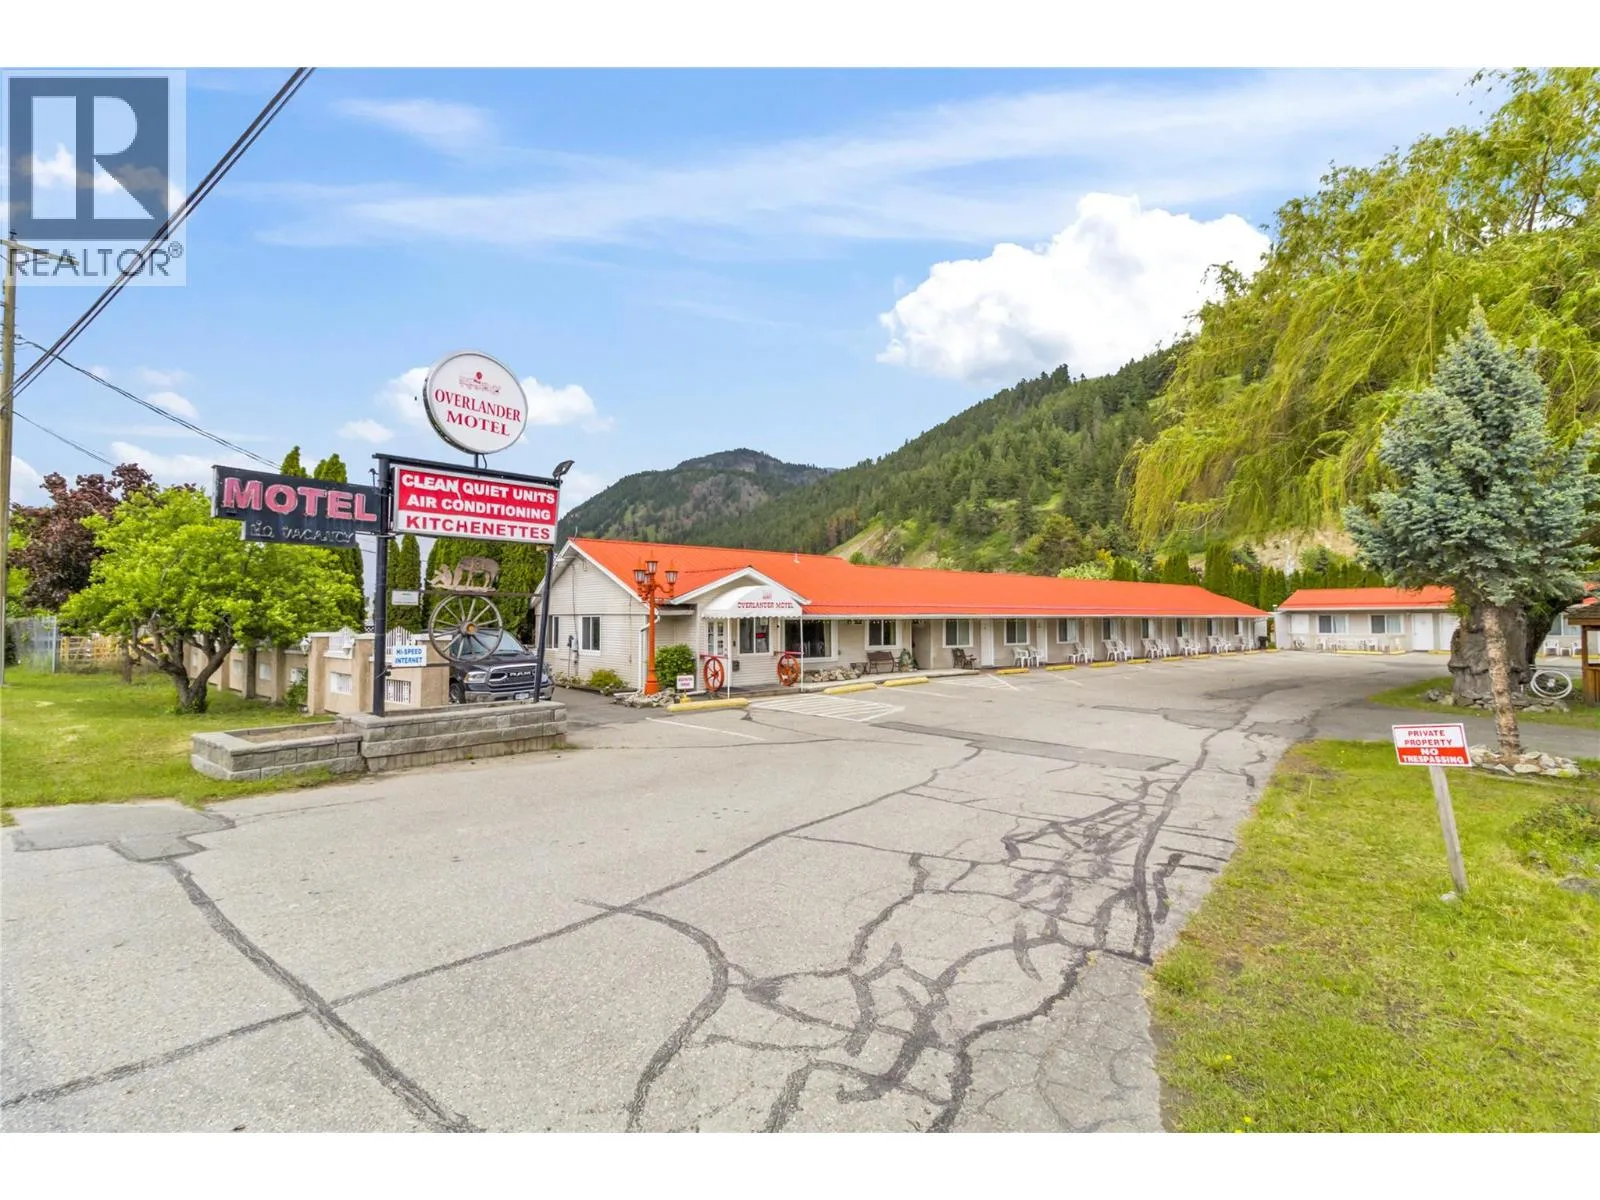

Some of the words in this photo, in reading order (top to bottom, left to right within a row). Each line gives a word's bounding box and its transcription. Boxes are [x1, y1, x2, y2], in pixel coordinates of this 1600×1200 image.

[435, 388, 521, 422] OVERLANDER
[446, 410, 511, 437] MOTEL
[222, 476, 378, 522] MOTEL
[401, 473, 459, 493] CLEAN
[462, 482, 509, 498] QUIET
[513, 488, 555, 504] UNITS
[406, 494, 437, 509] AIR
[441, 498, 550, 520] CONDITIONING
[406, 515, 550, 540] KITCHENETTES
[737, 601, 774, 609] OVERLANDER
[775, 601, 794, 609] MOTEL
[395, 656, 423, 664] INTERNET
[1402, 755, 1464, 764] TRESPASSING
[1420, 748, 1439, 756] NO
